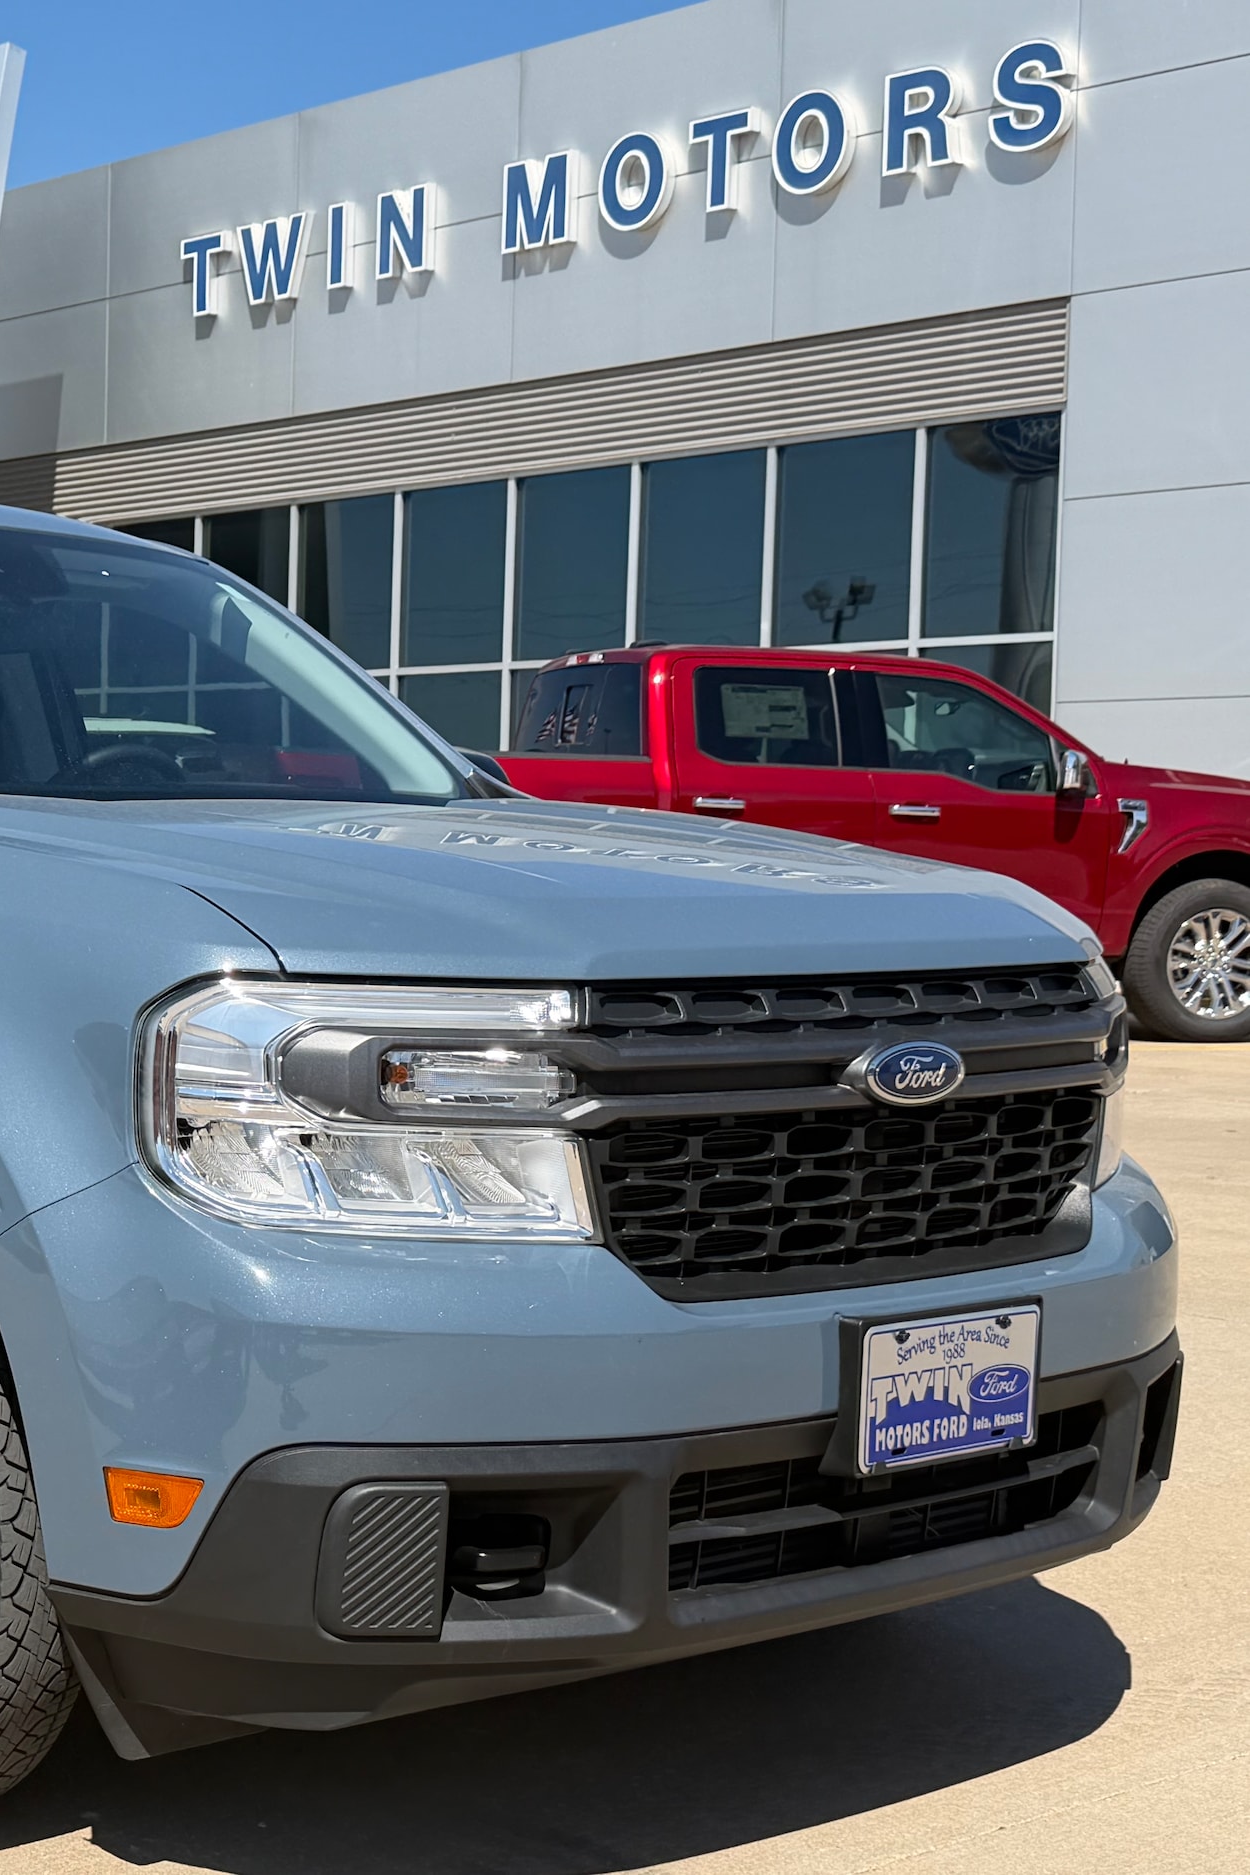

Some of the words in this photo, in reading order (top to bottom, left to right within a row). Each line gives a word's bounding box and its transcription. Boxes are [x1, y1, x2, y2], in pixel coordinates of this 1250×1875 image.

[180, 183, 434, 317] TWIN
[501, 37, 1075, 255] MOTORS
[895, 1055, 947, 1090] Ford
[897, 1337, 936, 1365] Serving
[938, 1325, 956, 1344] the
[958, 1324, 982, 1343] Area
[984, 1326, 1010, 1349] Since
[942, 1342, 966, 1364] 1988
[869, 1363, 973, 1426] TWIN
[979, 1370, 1018, 1397] Ford
[875, 1419, 930, 1452] MOTORS
[933, 1415, 968, 1442] FORD
[994, 1411, 1024, 1428] Kansas
